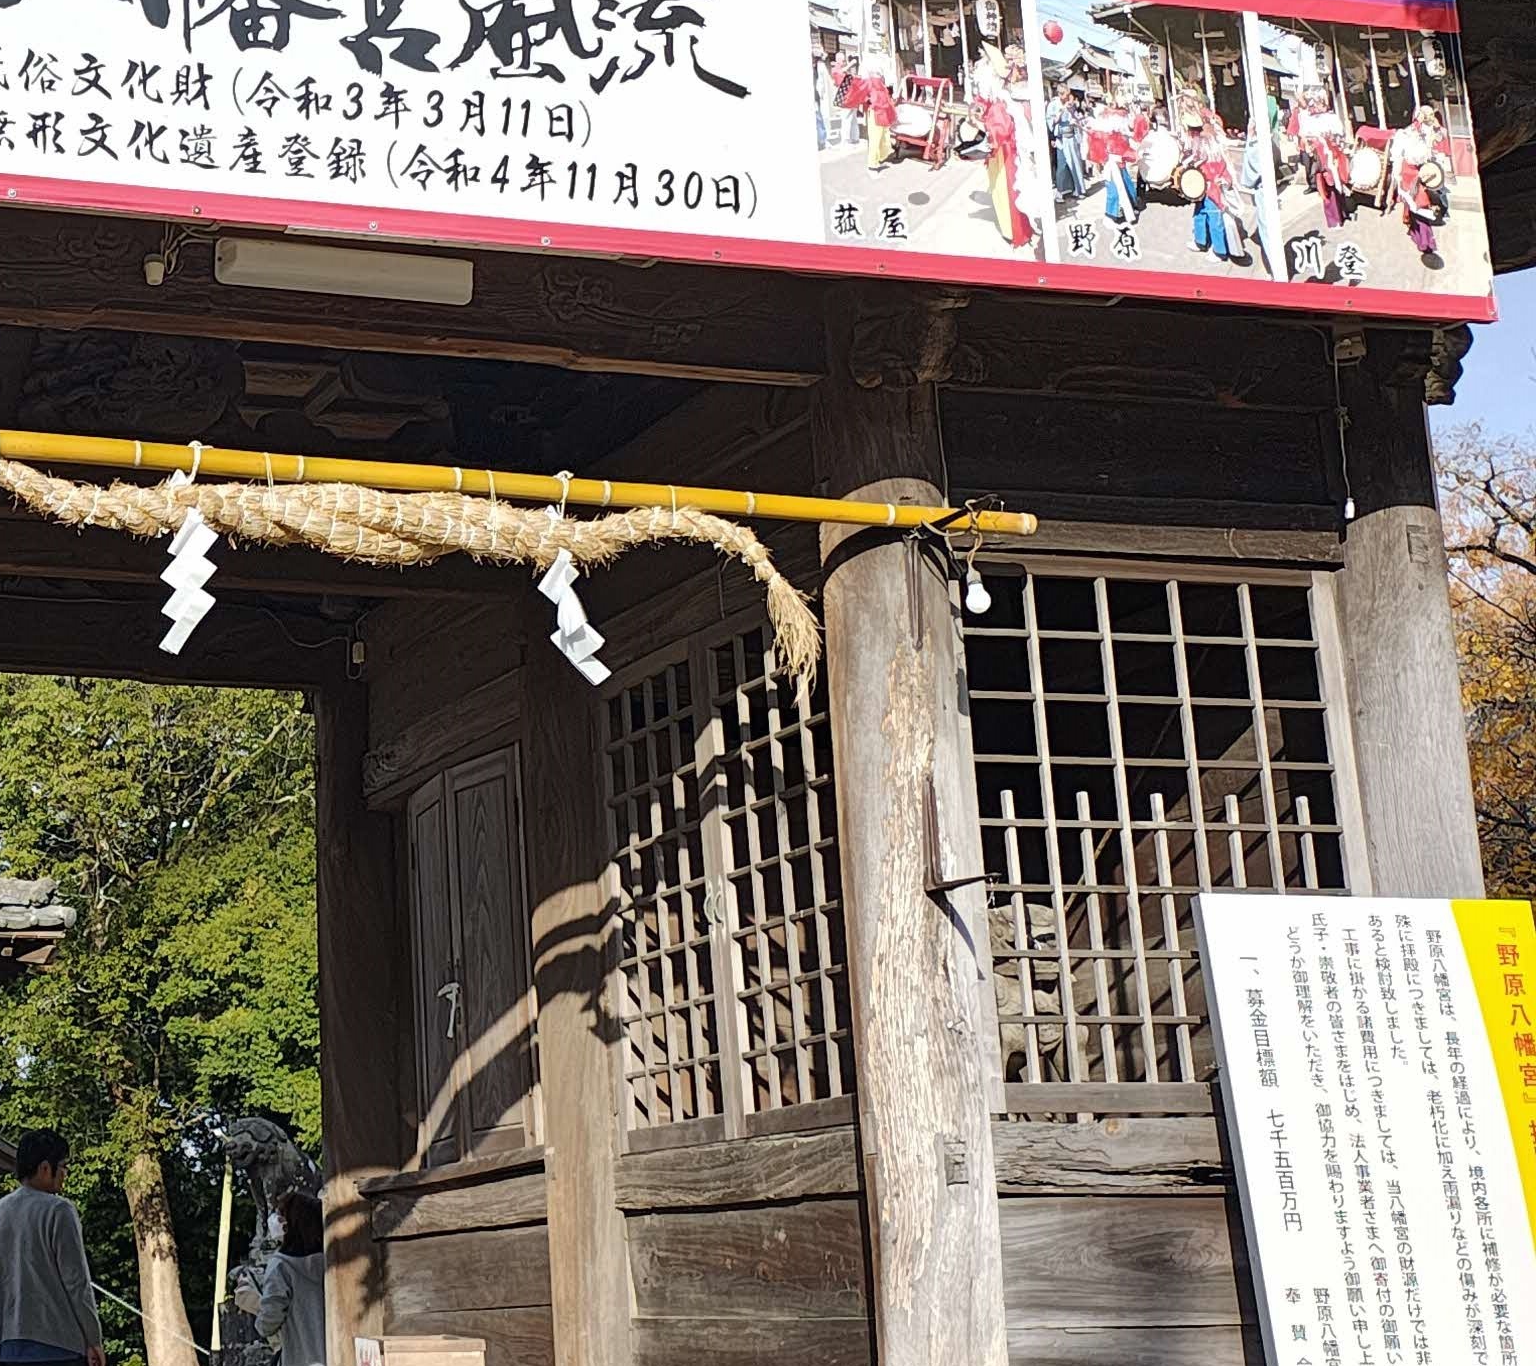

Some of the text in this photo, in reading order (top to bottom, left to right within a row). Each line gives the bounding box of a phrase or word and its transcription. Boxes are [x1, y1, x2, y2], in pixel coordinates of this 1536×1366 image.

[1068, 223, 1139, 259] 野原
[1300, 239, 1365, 278] 川登
[1267, 1109, 1302, 1232] 七千五百万円
